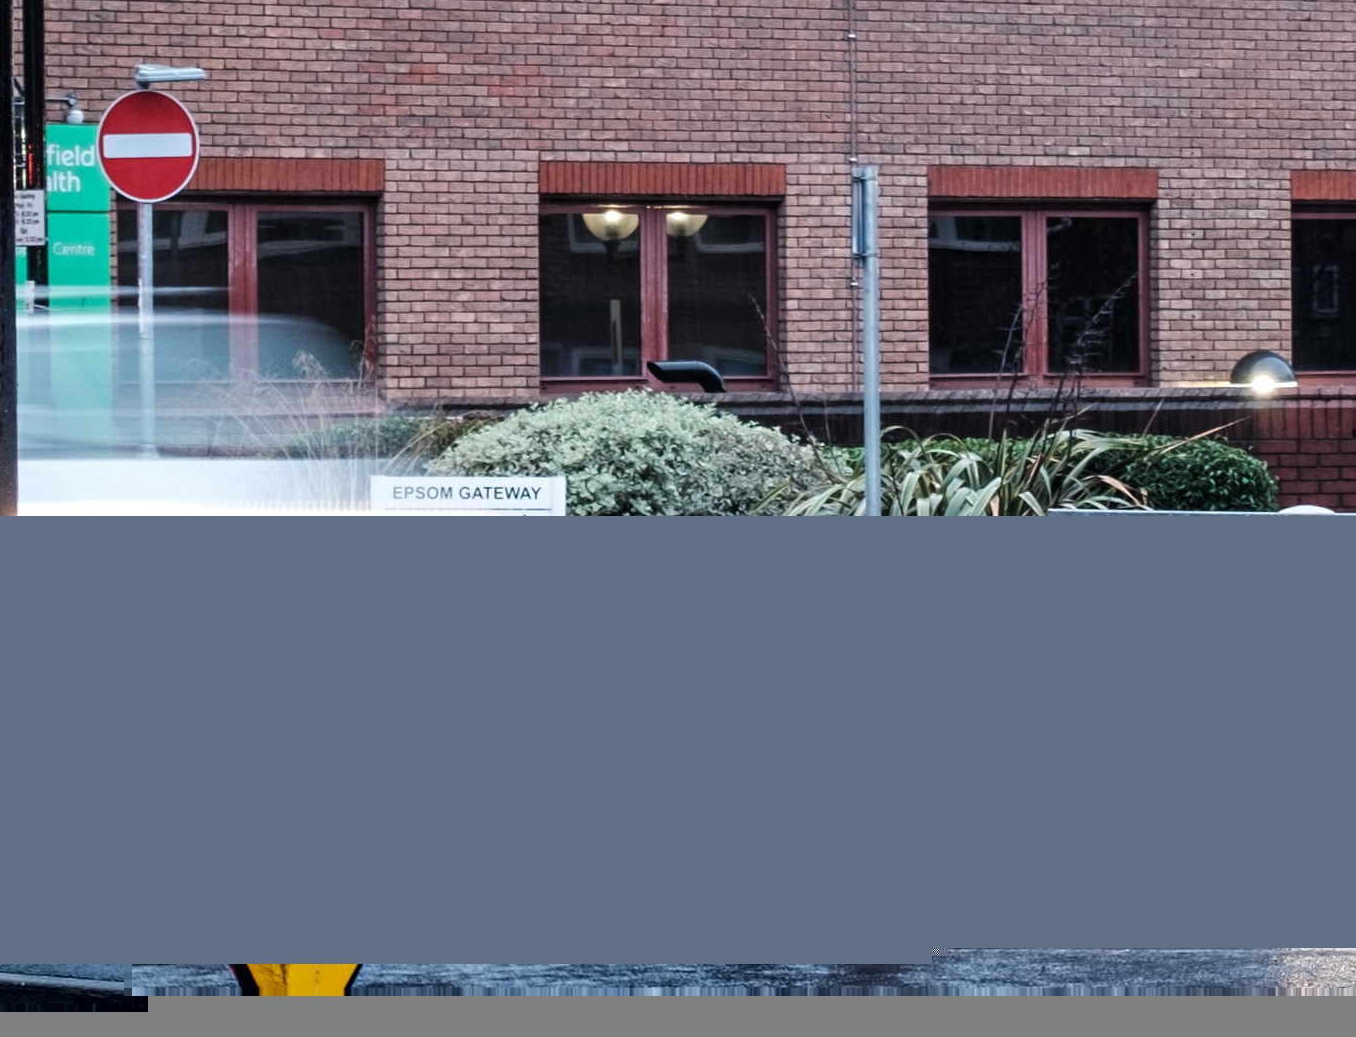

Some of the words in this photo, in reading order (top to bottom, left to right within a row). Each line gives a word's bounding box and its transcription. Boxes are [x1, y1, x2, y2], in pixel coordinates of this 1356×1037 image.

[53, 242, 96, 255] Centre
[392, 486, 453, 500] EPSOM
[458, 486, 542, 500] GATEWAY
